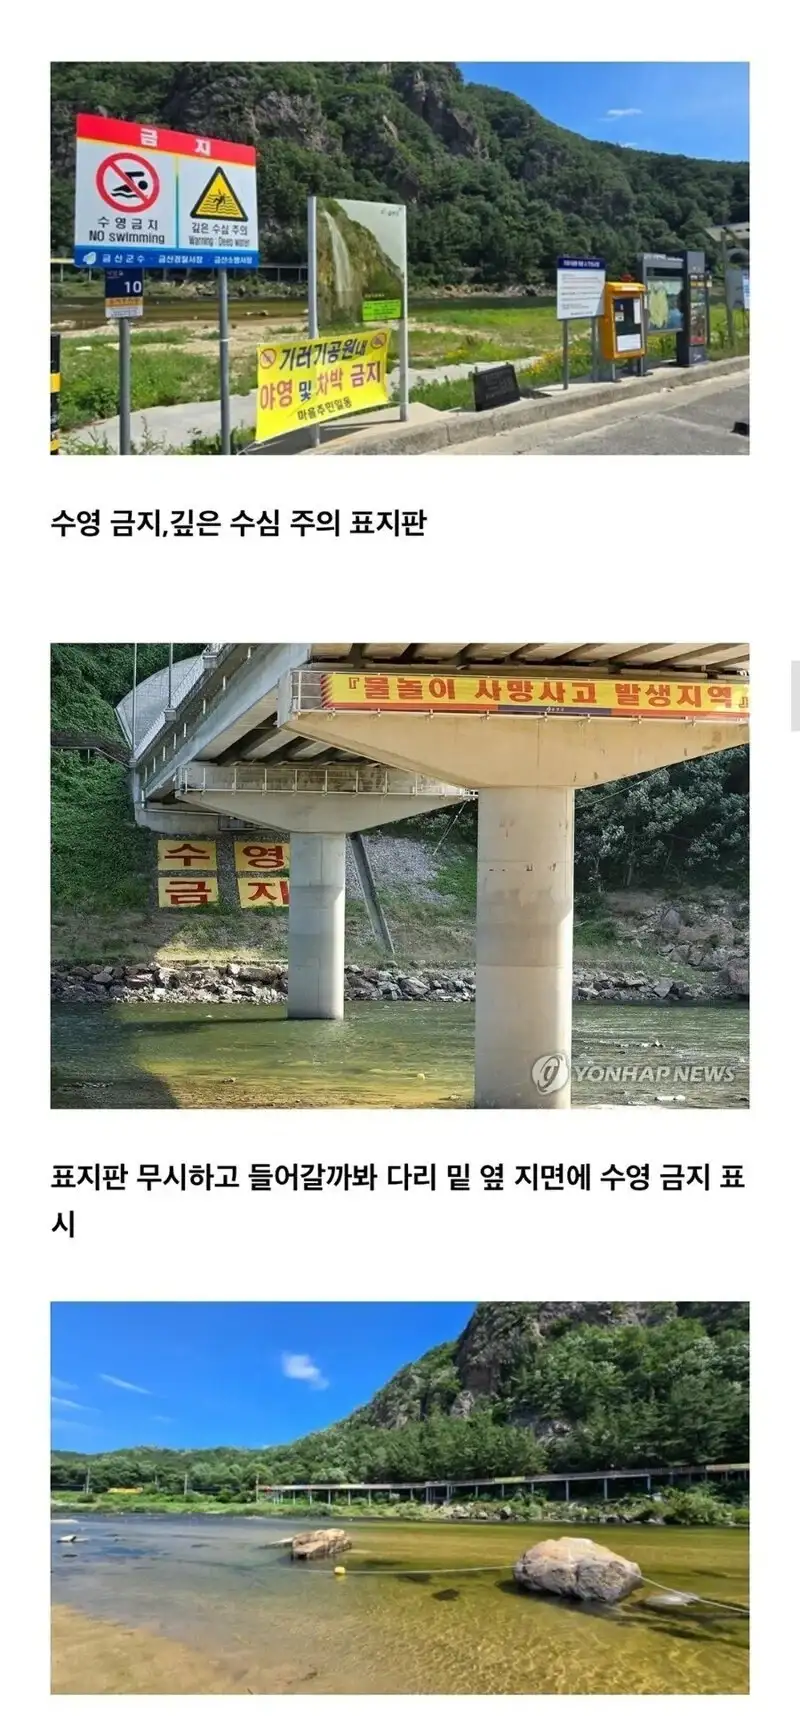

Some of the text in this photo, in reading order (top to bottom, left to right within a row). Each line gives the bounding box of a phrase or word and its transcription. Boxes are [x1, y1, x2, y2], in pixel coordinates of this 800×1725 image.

[89, 230, 165, 245] NO swimming
[191, 222, 248, 236] 깊은 수심 주의
[124, 281, 142, 294] 10
[279, 338, 369, 372] 기러기공원내
[259, 360, 382, 411] 야영 및 차박 금지
[297, 396, 352, 421] 마을주민일동
[474, 679, 596, 704] 사망사고
